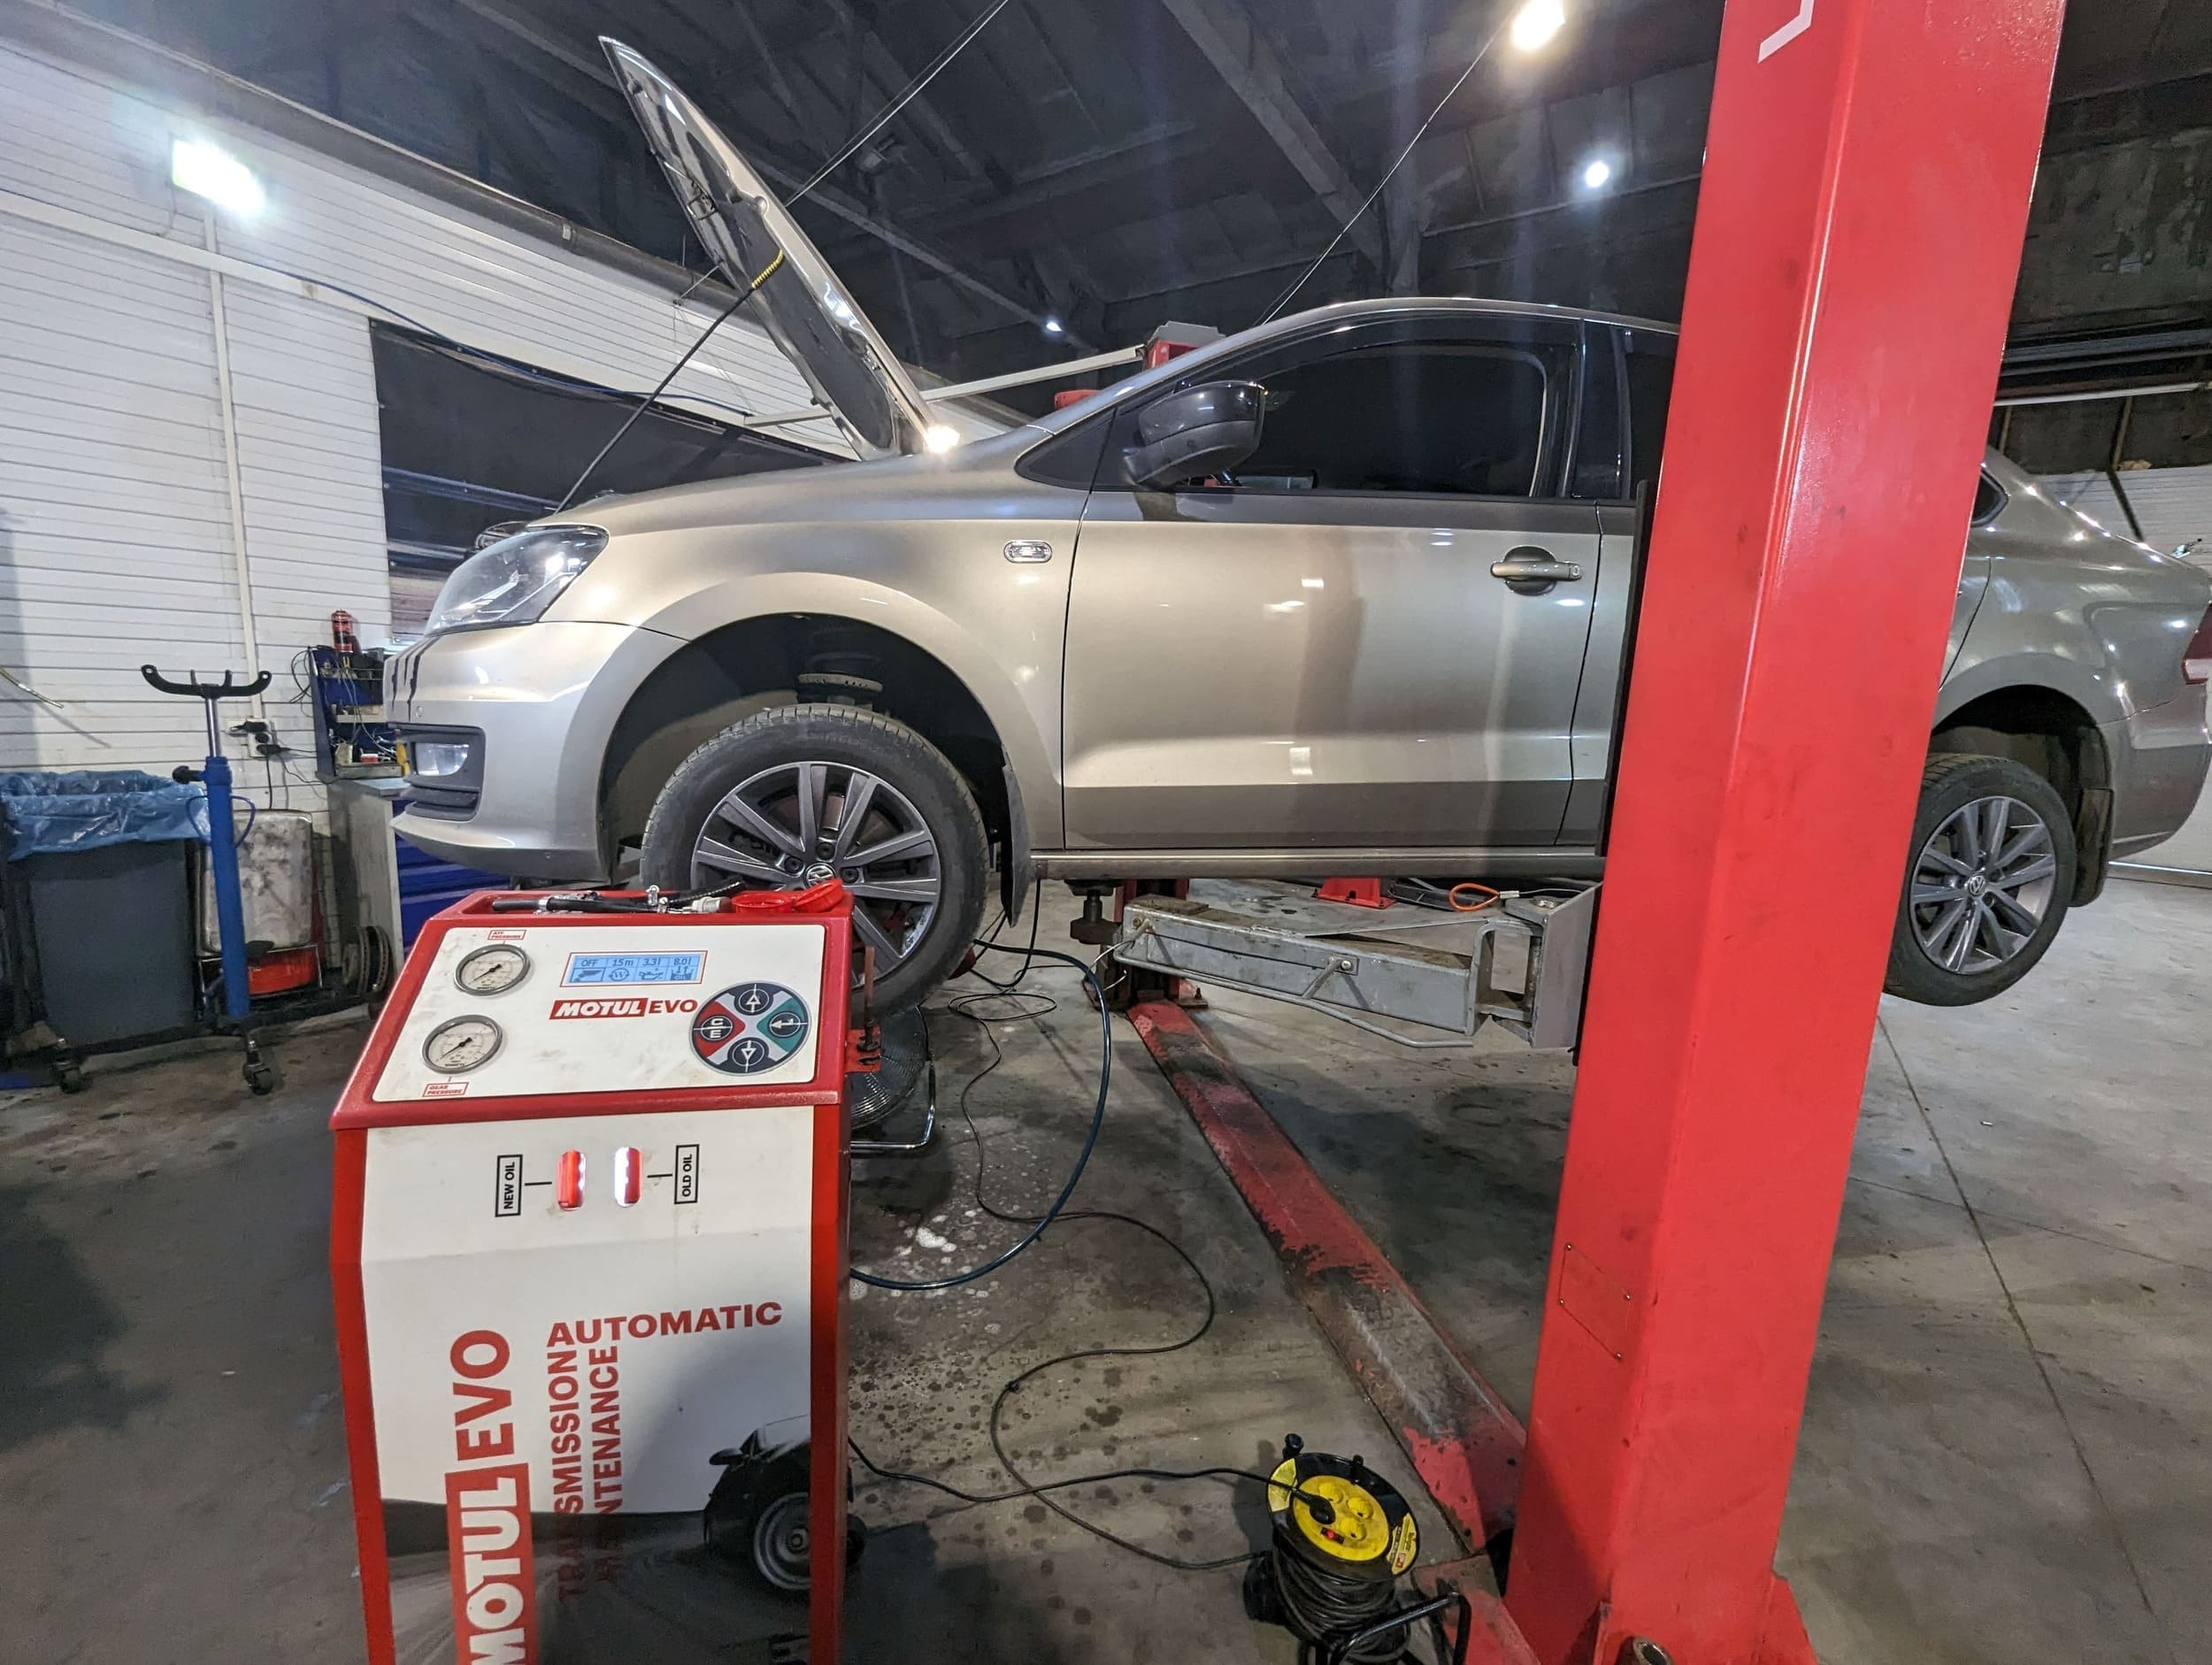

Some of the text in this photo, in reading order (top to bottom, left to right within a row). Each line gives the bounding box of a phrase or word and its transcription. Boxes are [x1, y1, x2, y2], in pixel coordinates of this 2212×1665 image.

[555, 999, 698, 1017] MOTUL EVO
[503, 1162, 516, 1209] NEW OIL
[681, 1154, 693, 1197] OLD OIL
[547, 1301, 783, 1347] AUTOMATIC
[449, 1329, 526, 1665] MOTUL EVO
